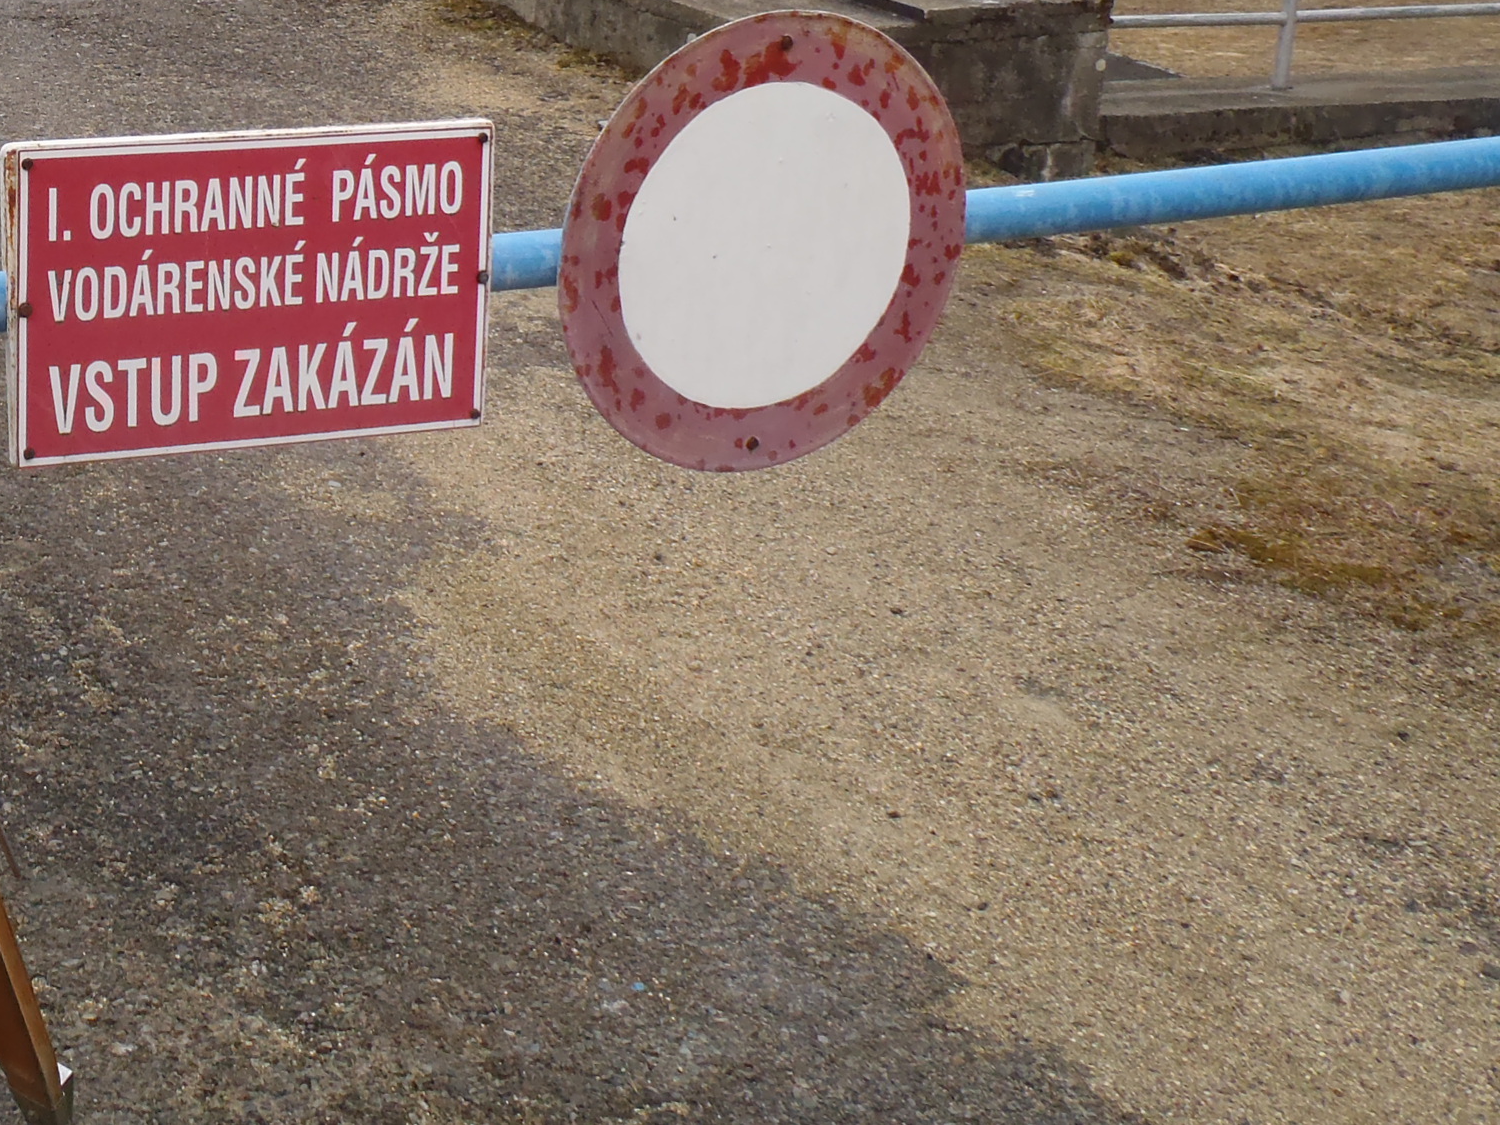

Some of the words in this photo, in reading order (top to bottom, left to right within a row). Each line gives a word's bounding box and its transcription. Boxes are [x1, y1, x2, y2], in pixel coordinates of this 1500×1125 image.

[48, 187, 72, 242] I.
[89, 158, 306, 241] OCHRANNÉ
[332, 153, 463, 222] PÁSMO
[48, 241, 304, 323] VODÁRENSKÉ
[316, 231, 461, 304] NÁDRŽE
[49, 352, 218, 435] VSTUP
[233, 318, 454, 419] ZAKÁZÁN
